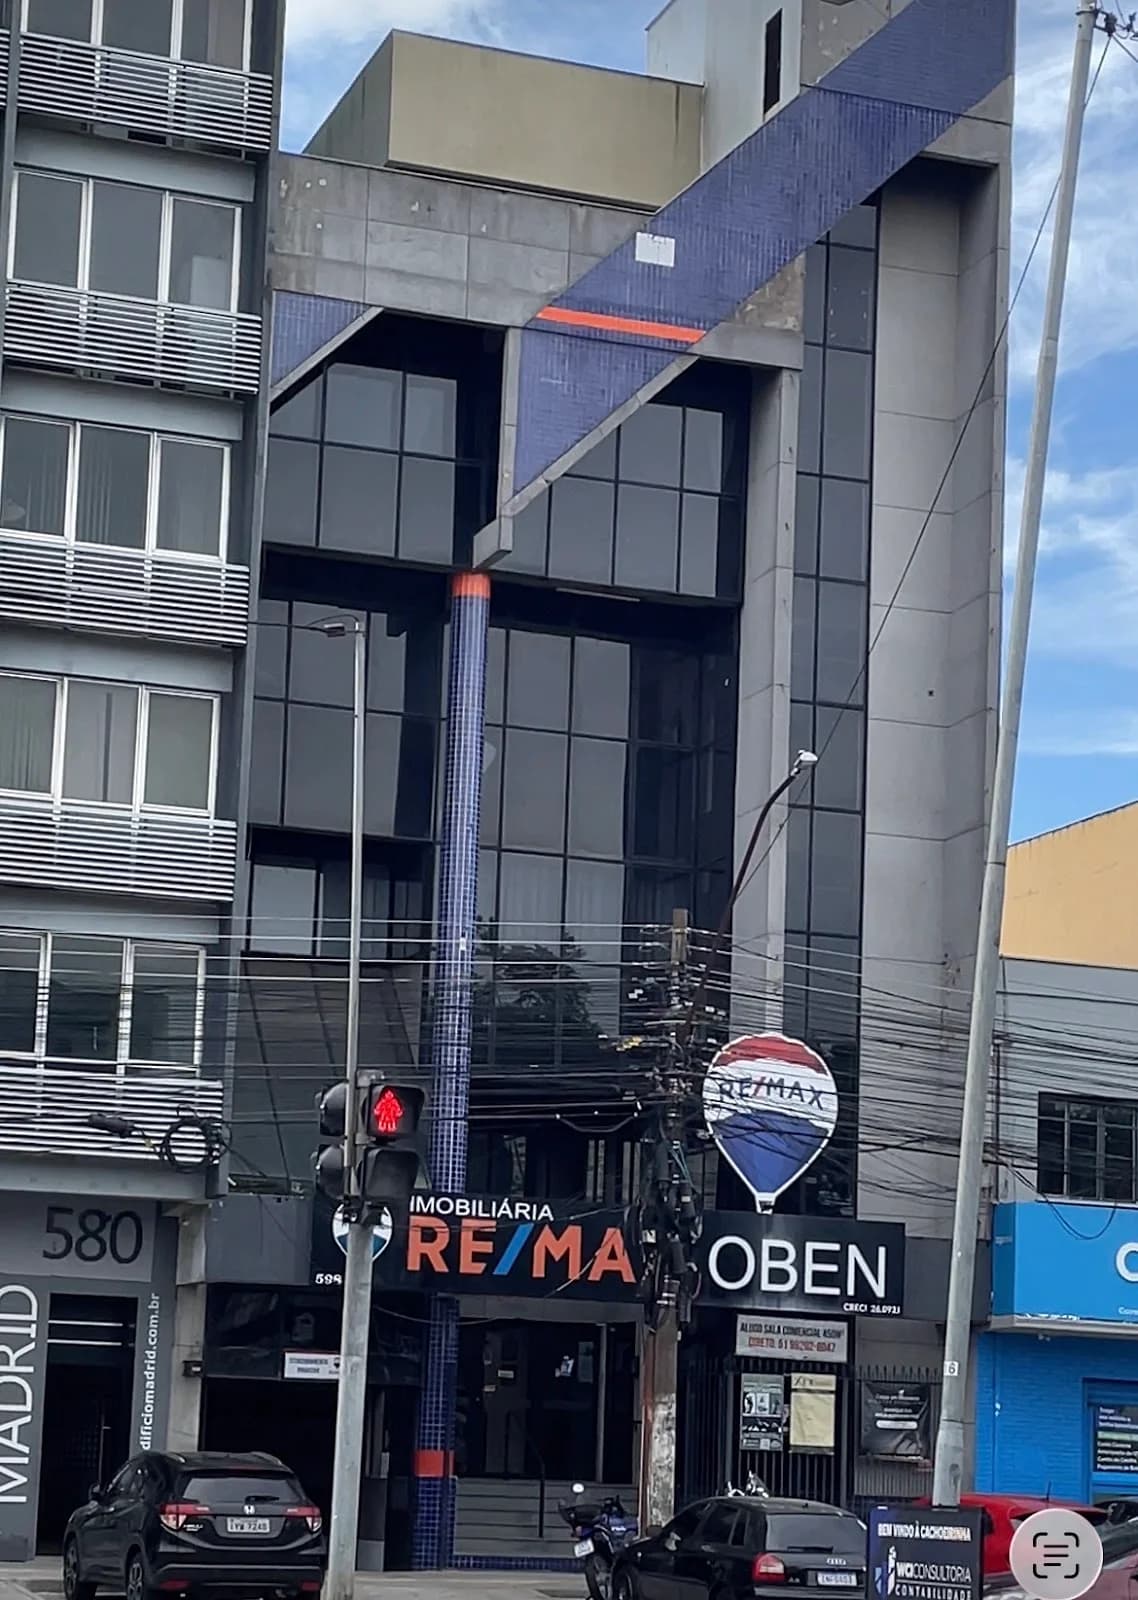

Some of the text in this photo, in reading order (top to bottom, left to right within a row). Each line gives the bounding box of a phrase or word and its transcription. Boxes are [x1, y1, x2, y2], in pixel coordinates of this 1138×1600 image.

[718, 1076, 824, 1110] RE/MAX
[409, 1195, 554, 1221] IMOBILIÁRIA
[42, 1206, 143, 1265] 580
[406, 1216, 637, 1283] RE/MA
[315, 1273, 342, 1285] 598
[708, 1235, 887, 1298] OBEN
[843, 1302, 868, 1312] CRECI
[764, 1324, 781, 1334] SALA
[139, 1293, 160, 1450] dificiomadrid.com.br
[0, 1284, 38, 1502] MADRID
[878, 1523, 892, 1537] BEM
[893, 1523, 914, 1538] VINDO
[895, 1584, 971, 1600] CONTABILIDADE
